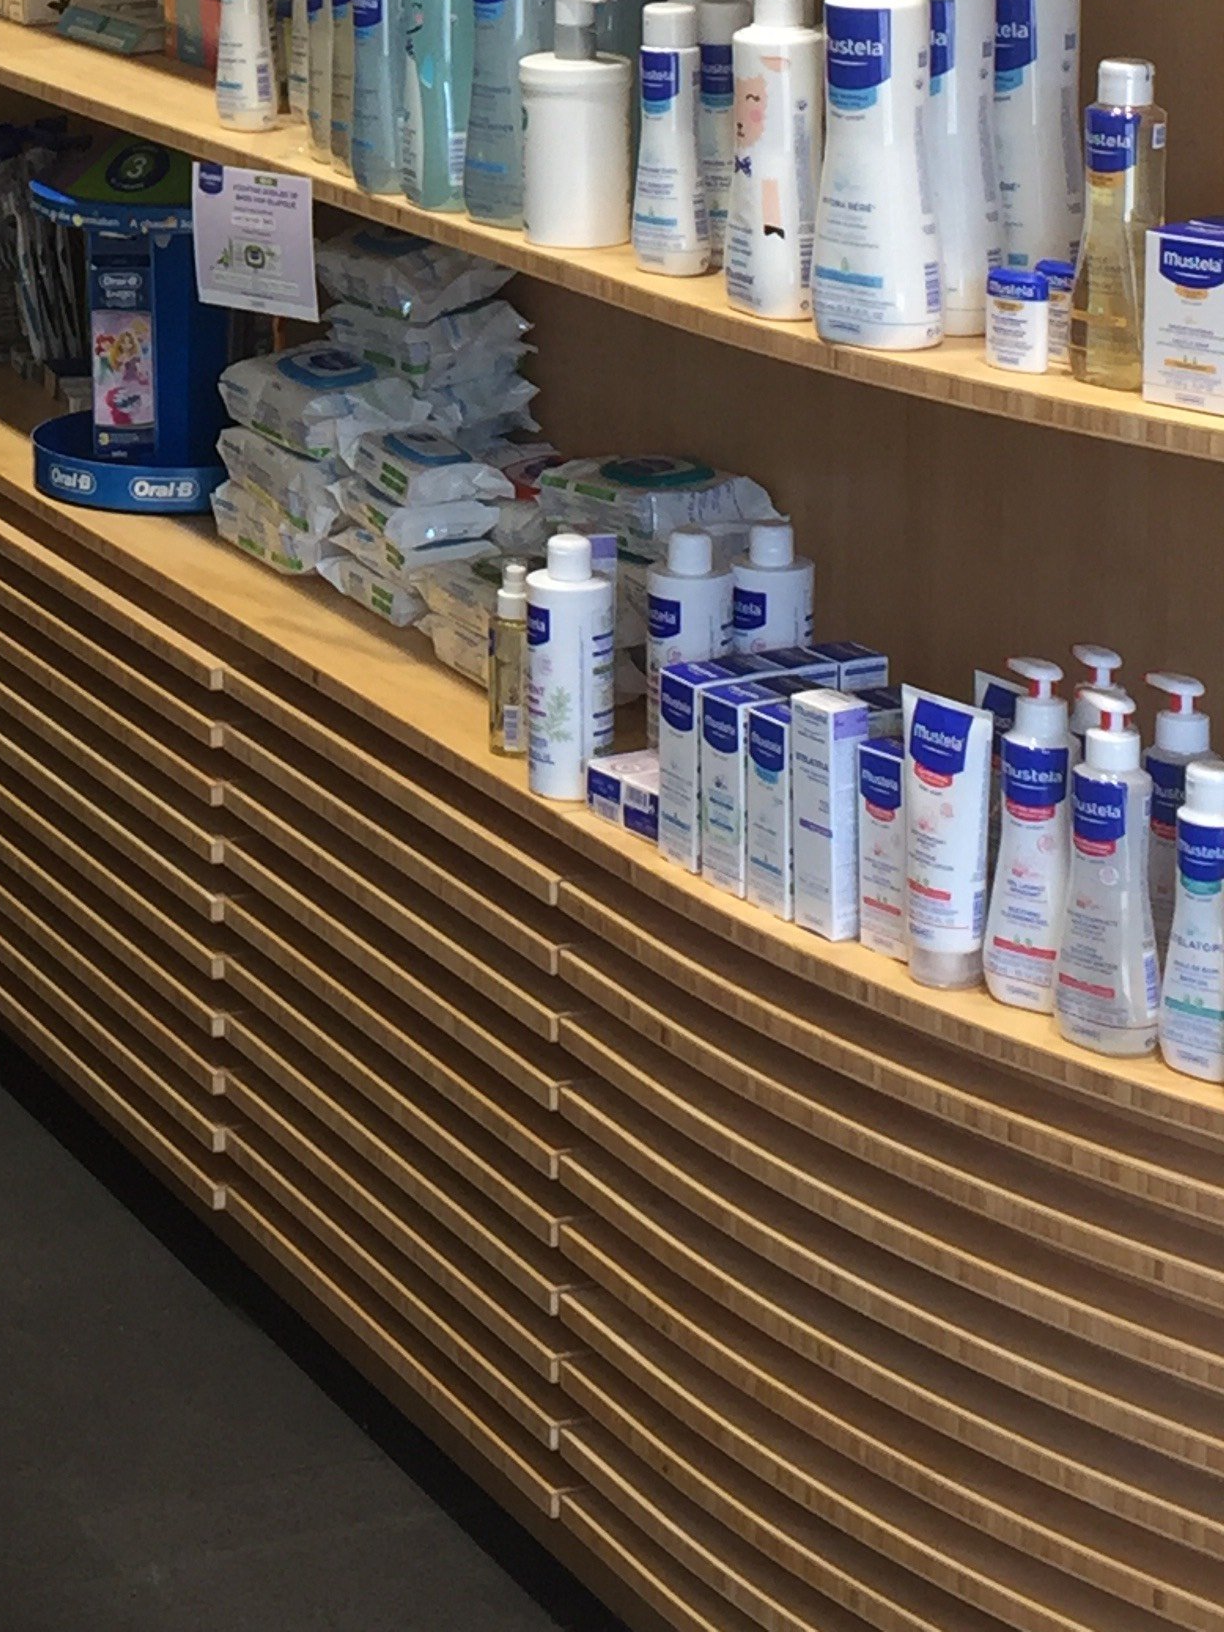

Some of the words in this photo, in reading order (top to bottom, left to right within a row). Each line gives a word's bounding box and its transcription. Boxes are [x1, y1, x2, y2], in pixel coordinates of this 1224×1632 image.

[995, 21, 1029, 40] tela
[828, 39, 885, 57] ustela
[1163, 251, 1222, 273] Mustela
[133, 480, 193, 498] Oral-B
[913, 723, 964, 752] Mustela
